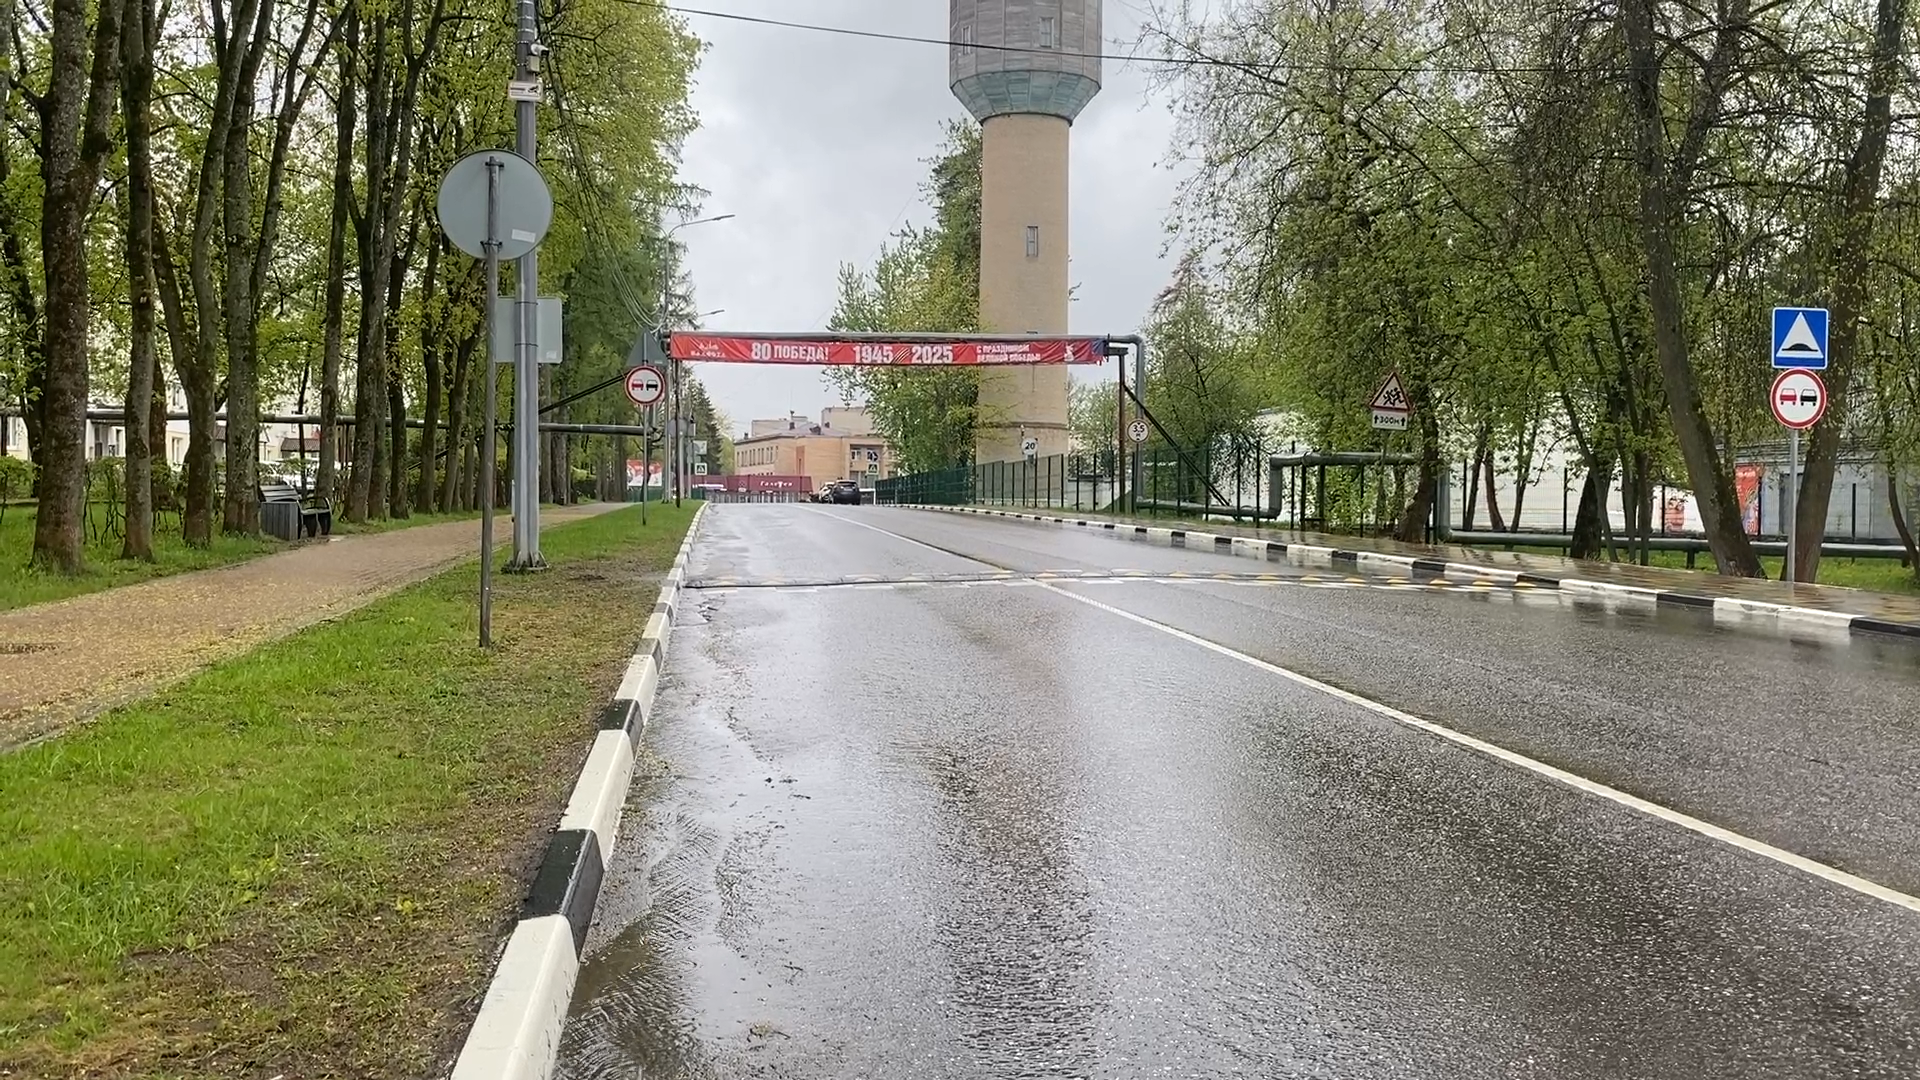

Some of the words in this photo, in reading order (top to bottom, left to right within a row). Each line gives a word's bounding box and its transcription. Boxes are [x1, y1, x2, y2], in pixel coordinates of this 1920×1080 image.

[751, 342, 772, 360] 80
[774, 345, 829, 362] ПОБЕДА!
[853, 345, 894, 364] 1945
[911, 345, 954, 364] 2025
[1025, 441, 1036, 450] 20
